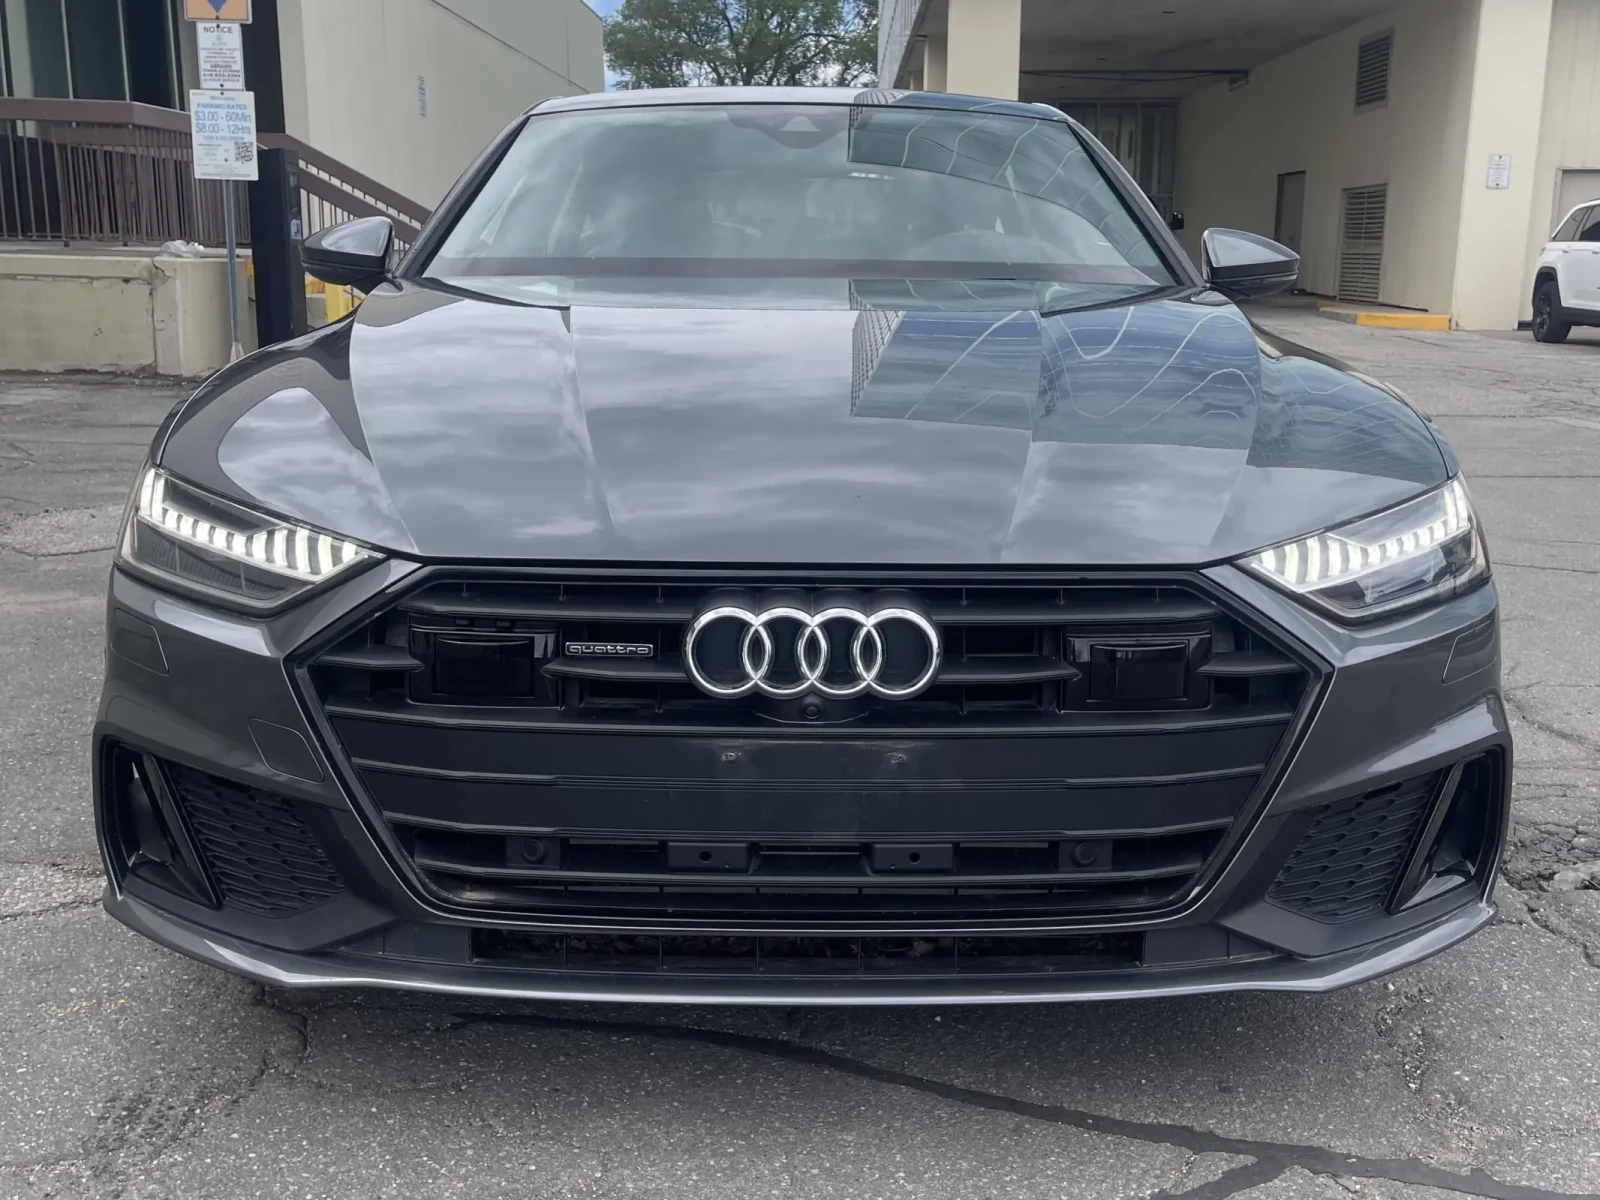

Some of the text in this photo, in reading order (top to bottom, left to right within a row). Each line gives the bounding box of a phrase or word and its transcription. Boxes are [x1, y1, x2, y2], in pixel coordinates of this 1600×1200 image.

[203, 26, 233, 34] NOTICE
[226, 103, 248, 111] RATES
[195, 110, 219, 121] $3.00
[225, 111, 252, 122] 60Min
[195, 122, 220, 134] $8.00
[227, 124, 252, 135] 12Hrs
[569, 645, 648, 654] quattro
